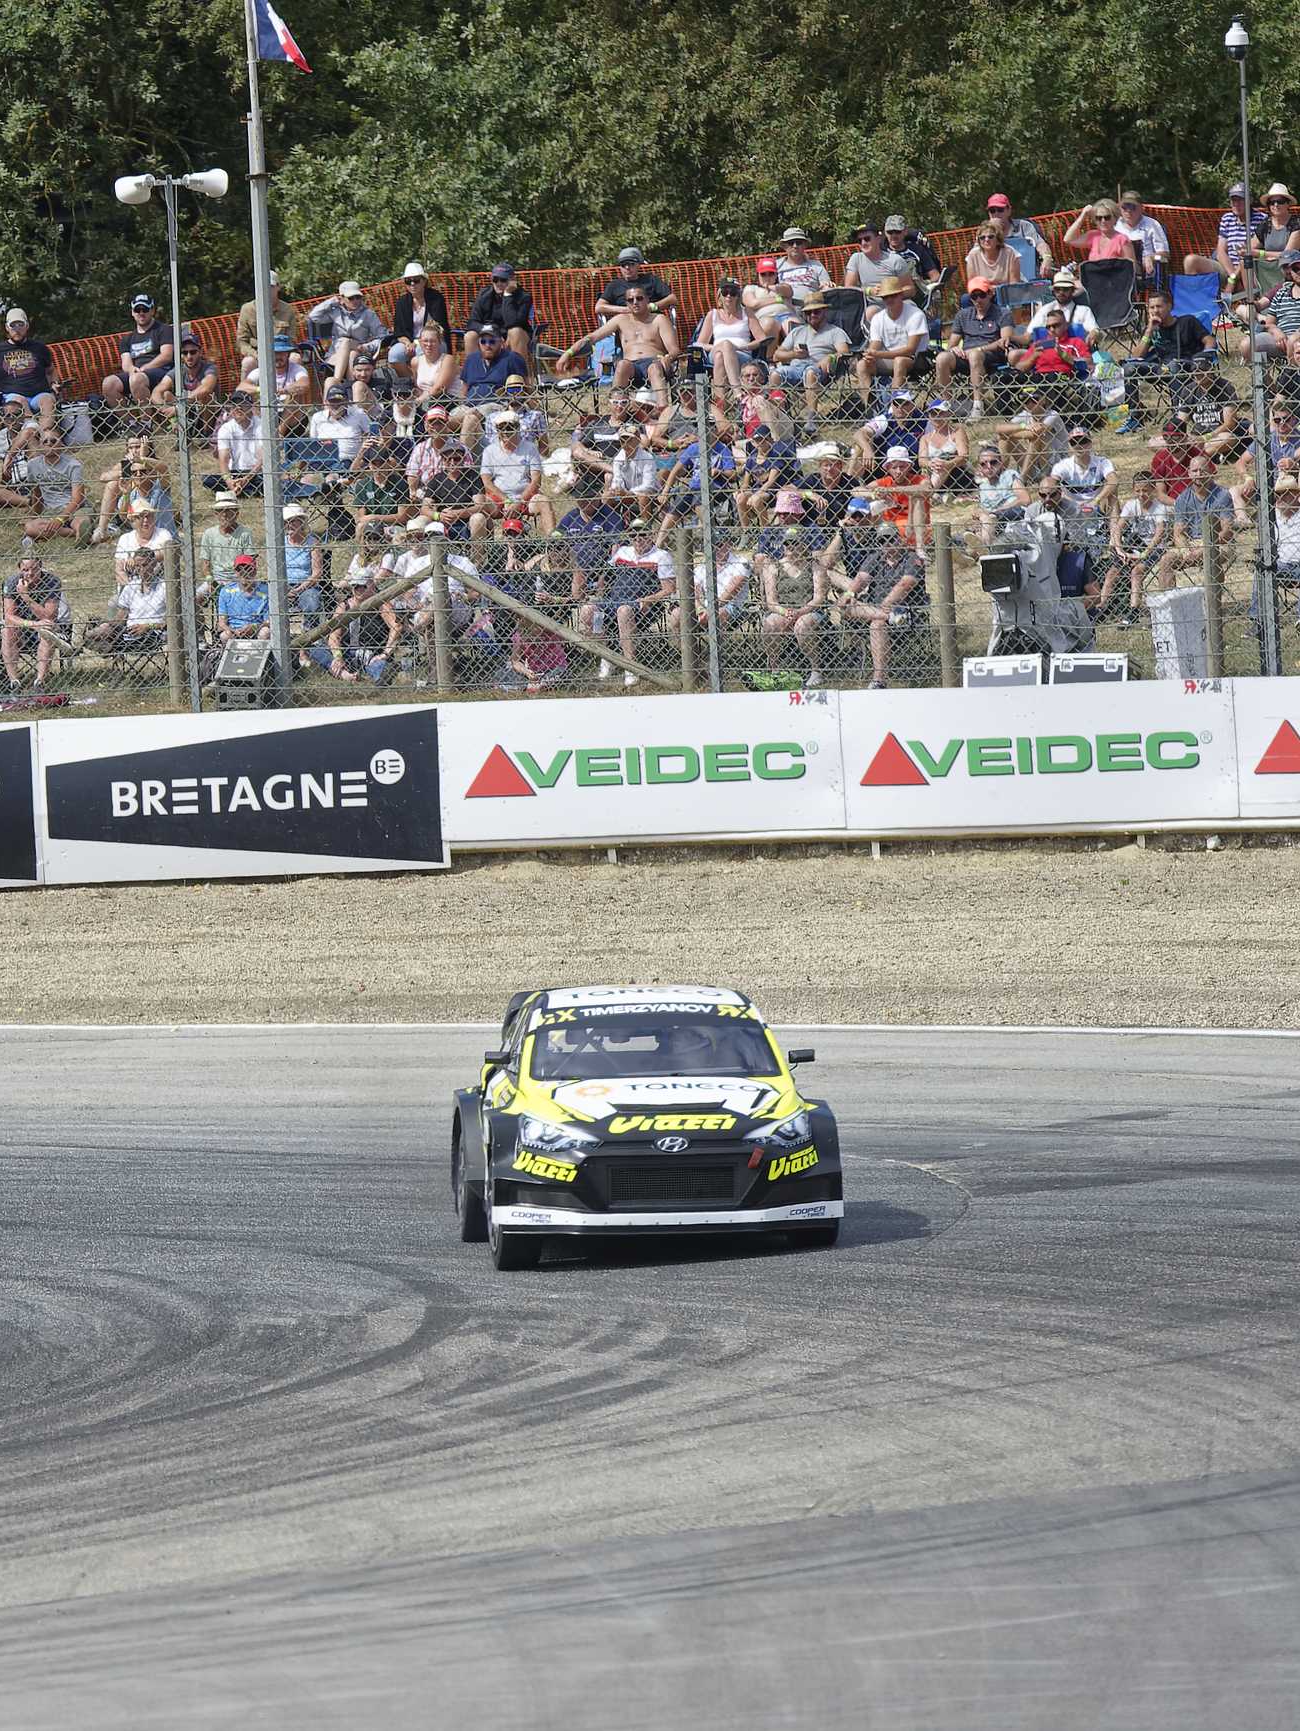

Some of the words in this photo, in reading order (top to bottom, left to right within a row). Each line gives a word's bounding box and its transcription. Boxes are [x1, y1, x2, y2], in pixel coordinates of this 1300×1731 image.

[514, 743, 806, 789] VEIDEC
[907, 732, 1201, 778] VEIDEC
[111, 771, 367, 817] BRETAGNE
[579, 1004, 713, 1017] TIMERZYANOV
[511, 1211, 553, 1219] COOPER
[789, 1205, 827, 1216] COOPER
